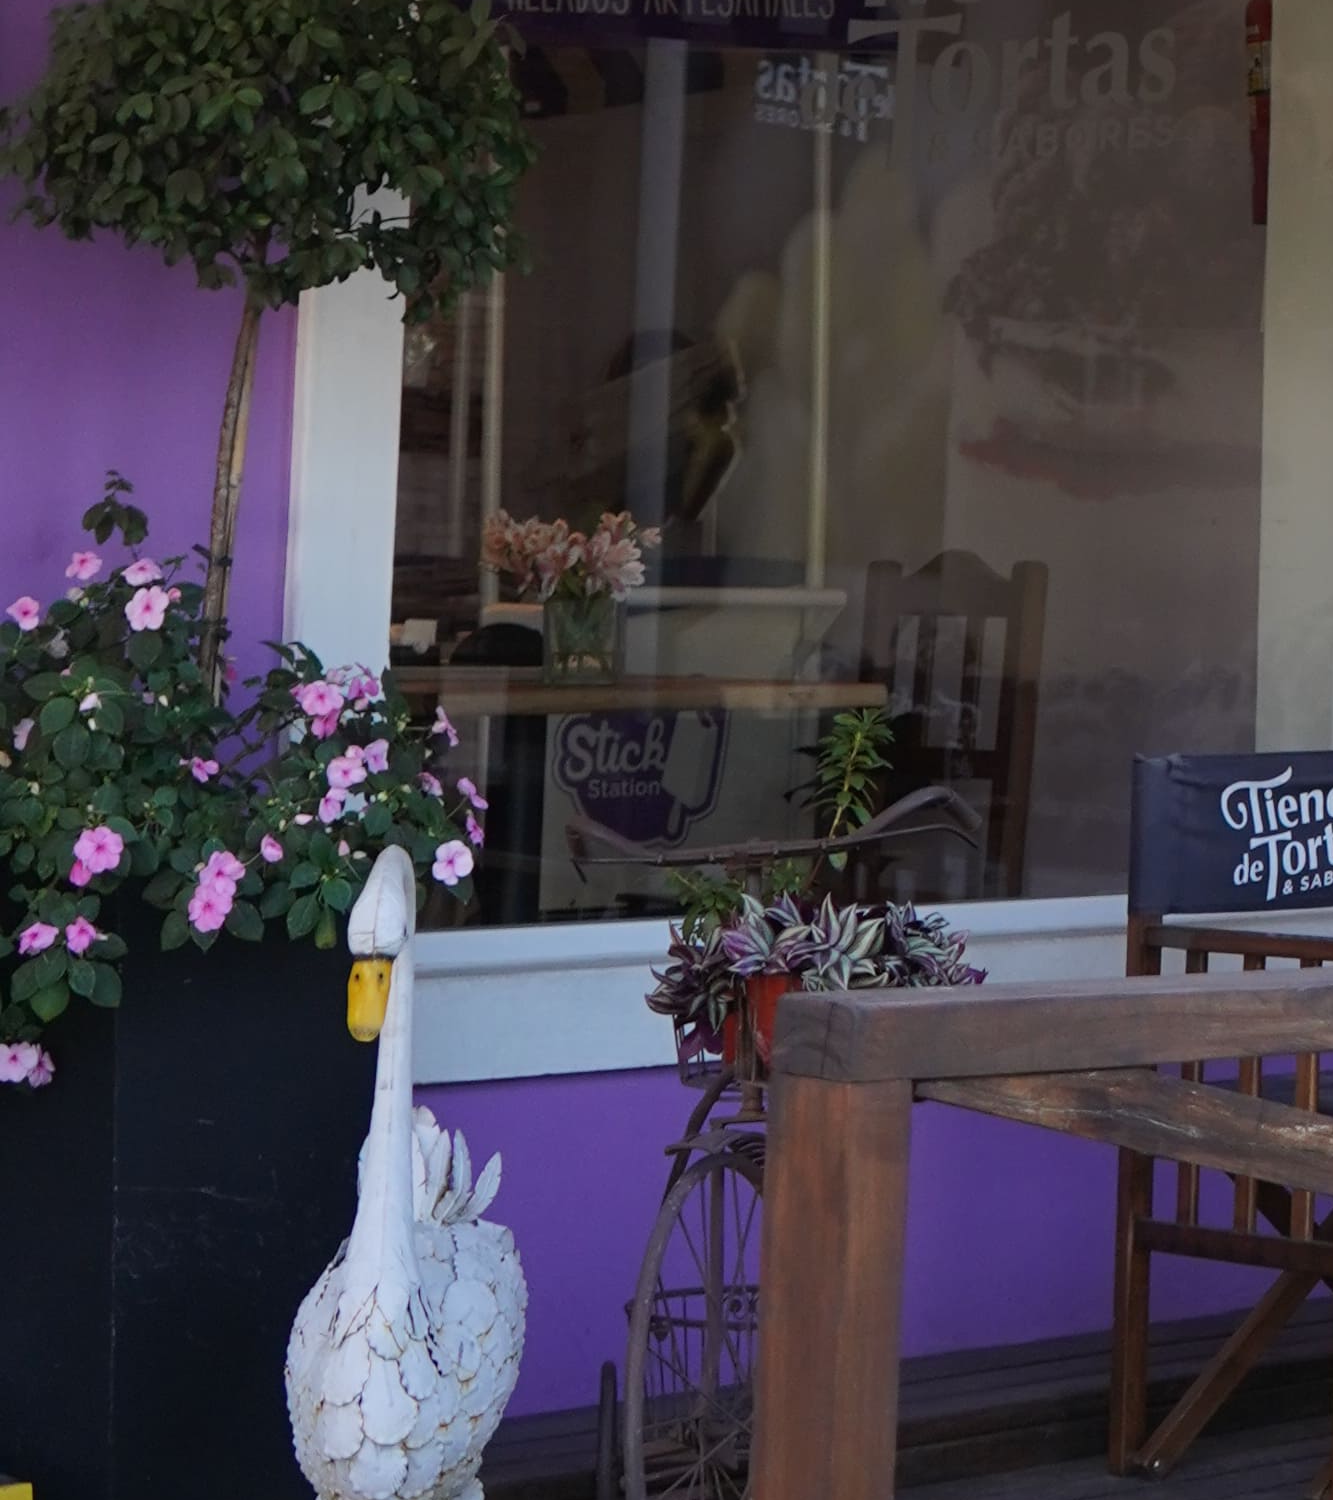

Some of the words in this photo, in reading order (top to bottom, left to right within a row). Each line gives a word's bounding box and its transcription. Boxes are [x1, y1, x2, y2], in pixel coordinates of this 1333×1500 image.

[847, 10, 1177, 169] Tortas
[566, 720, 665, 780] Stick
[587, 779, 660, 799] Station
[1233, 853, 1264, 885] de
[1282, 879, 1293, 895] &
